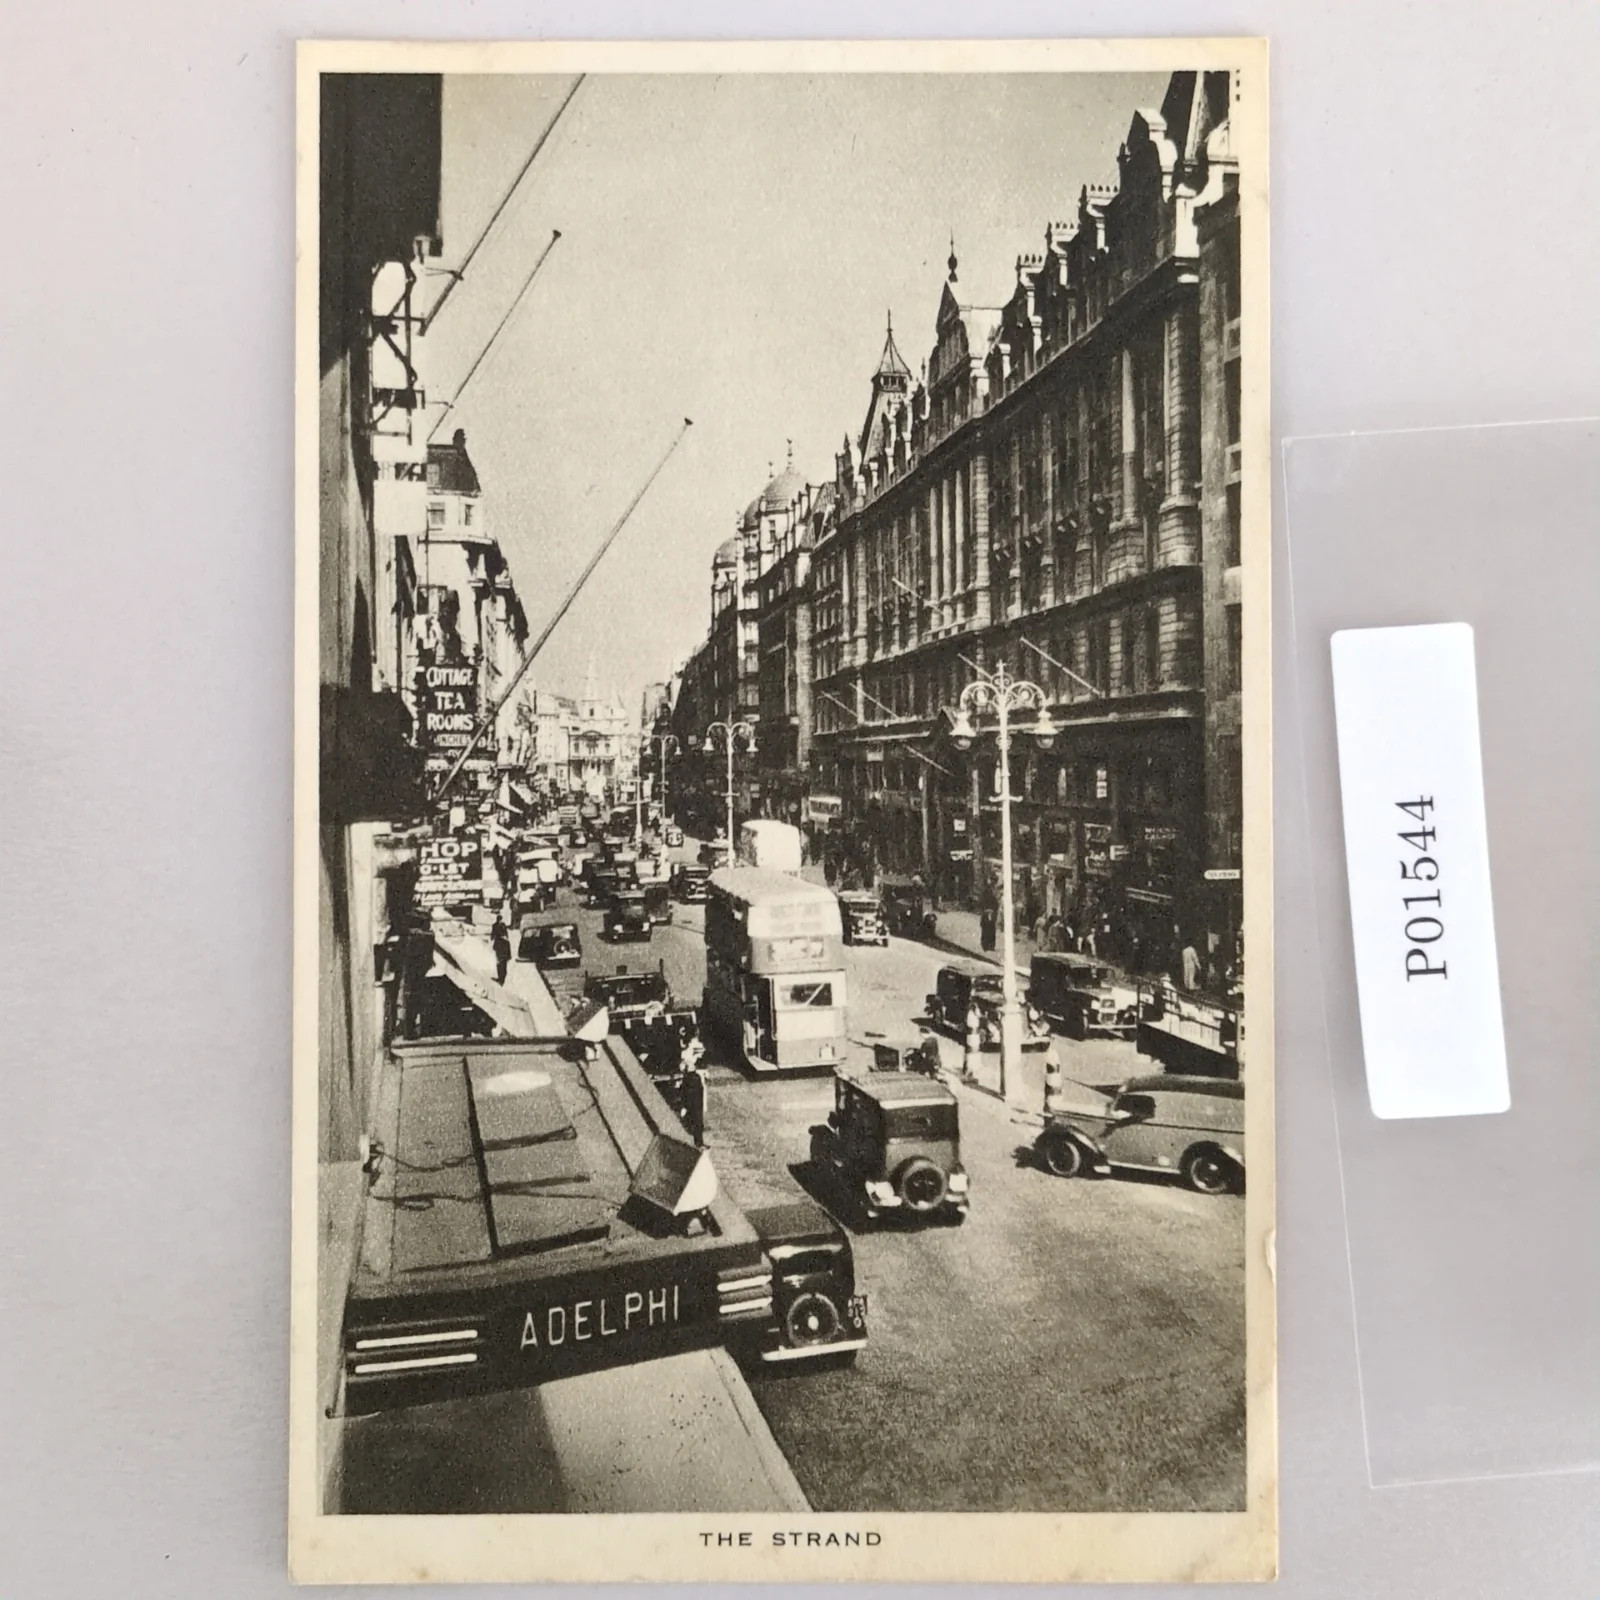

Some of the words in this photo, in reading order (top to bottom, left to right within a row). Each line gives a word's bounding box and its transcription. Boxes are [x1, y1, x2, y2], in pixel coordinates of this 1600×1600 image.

[426, 667, 474, 688] COTTAGE
[434, 691, 465, 710] TEA
[427, 713, 474, 731] ROOMS
[1395, 795, 1448, 983] P01544
[520, 1285, 679, 1350] ADELPHI
[699, 1532, 753, 1547] THE
[772, 1532, 882, 1547] STRAND
